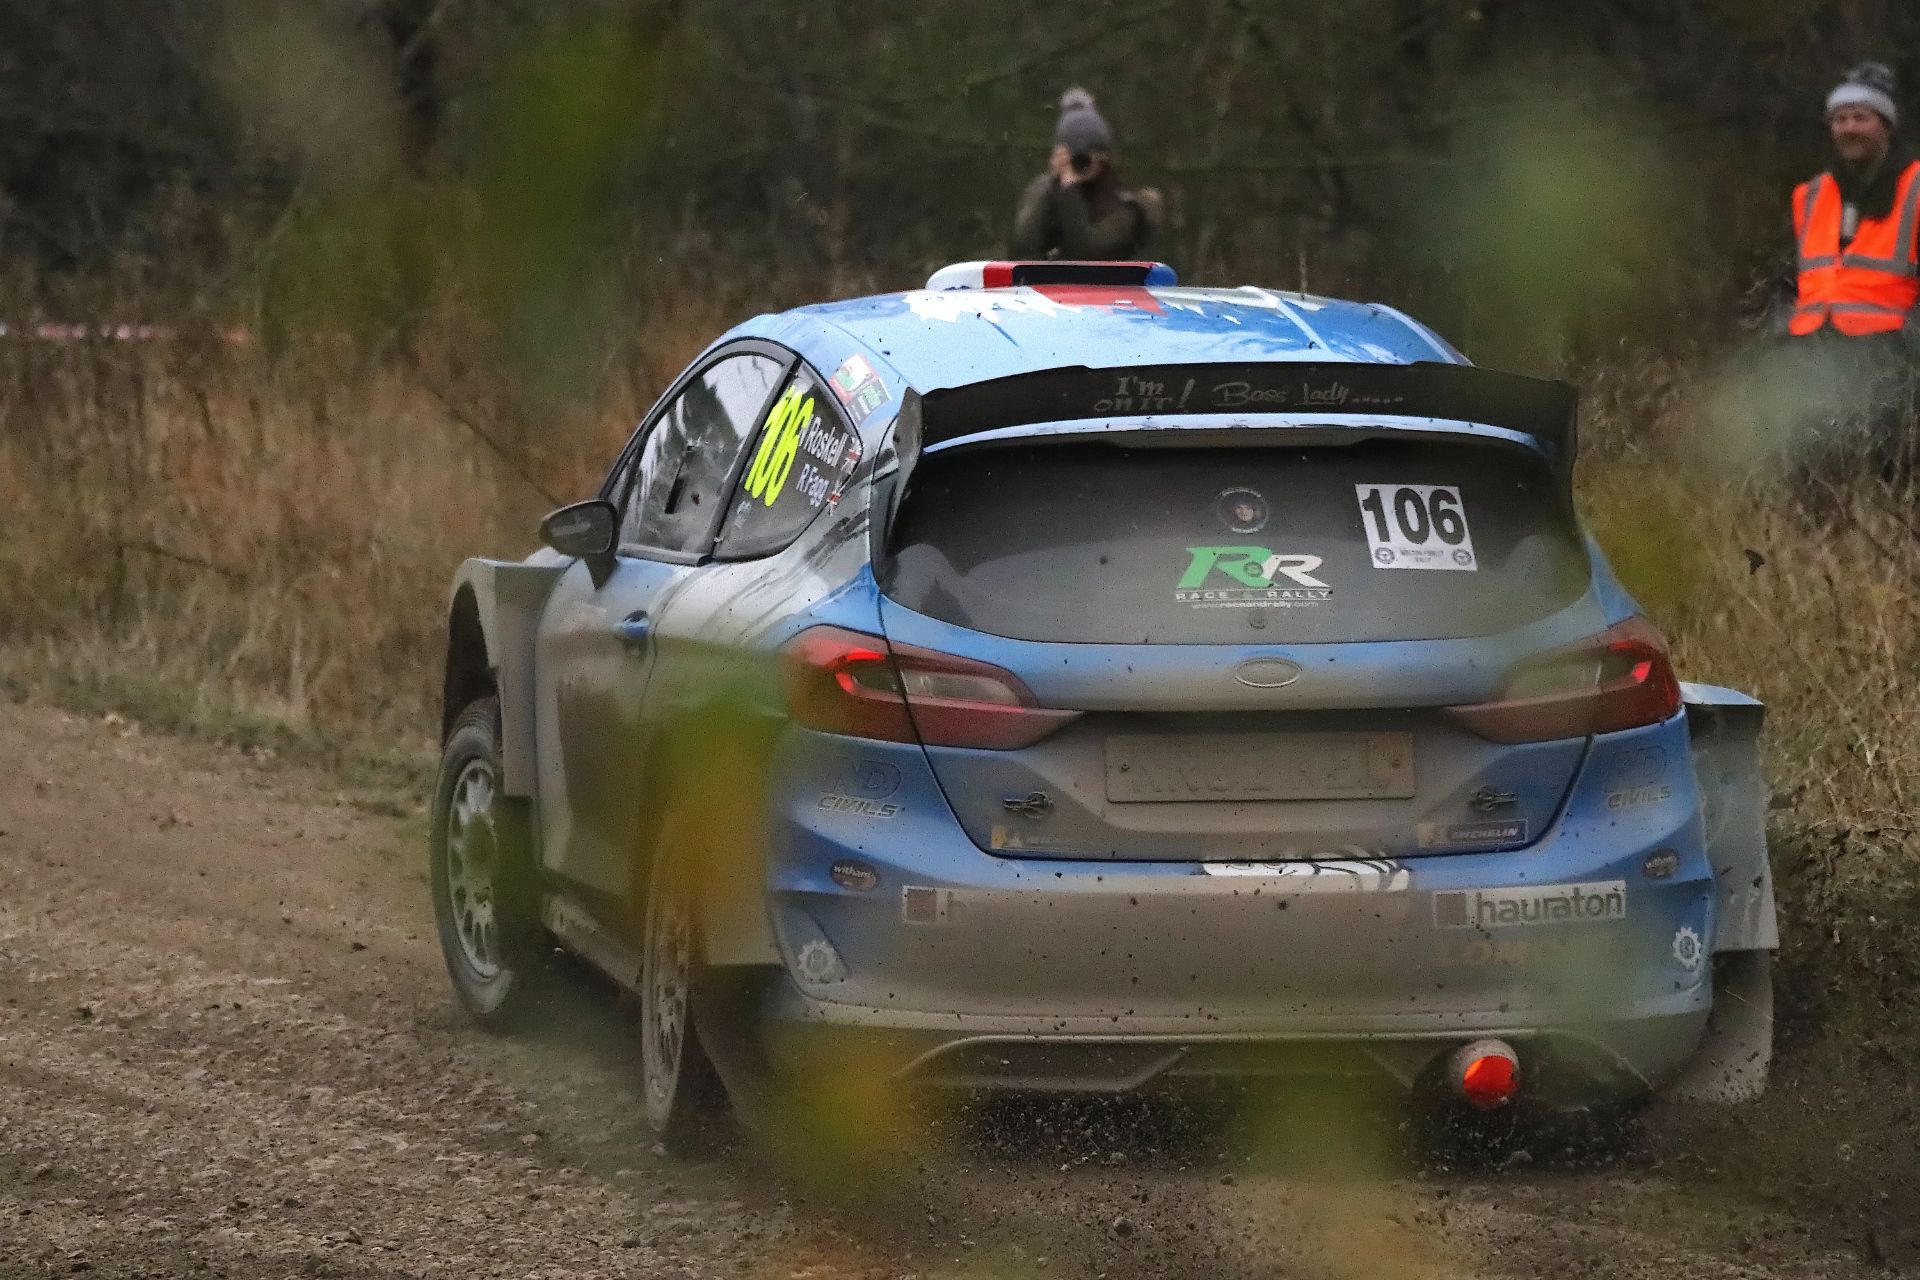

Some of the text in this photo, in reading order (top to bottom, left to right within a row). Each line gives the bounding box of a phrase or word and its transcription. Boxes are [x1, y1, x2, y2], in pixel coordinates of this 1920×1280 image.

[1115, 375, 1164, 397] I'm
[1211, 381, 1288, 407] Boss
[744, 385, 814, 507] 106
[803, 416, 849, 467] Roskell
[1362, 488, 1465, 545] 106
[1175, 590, 1329, 600] RACE RALLY
[817, 795, 901, 819] CIVILS
[1476, 887, 1623, 924] hauraton
